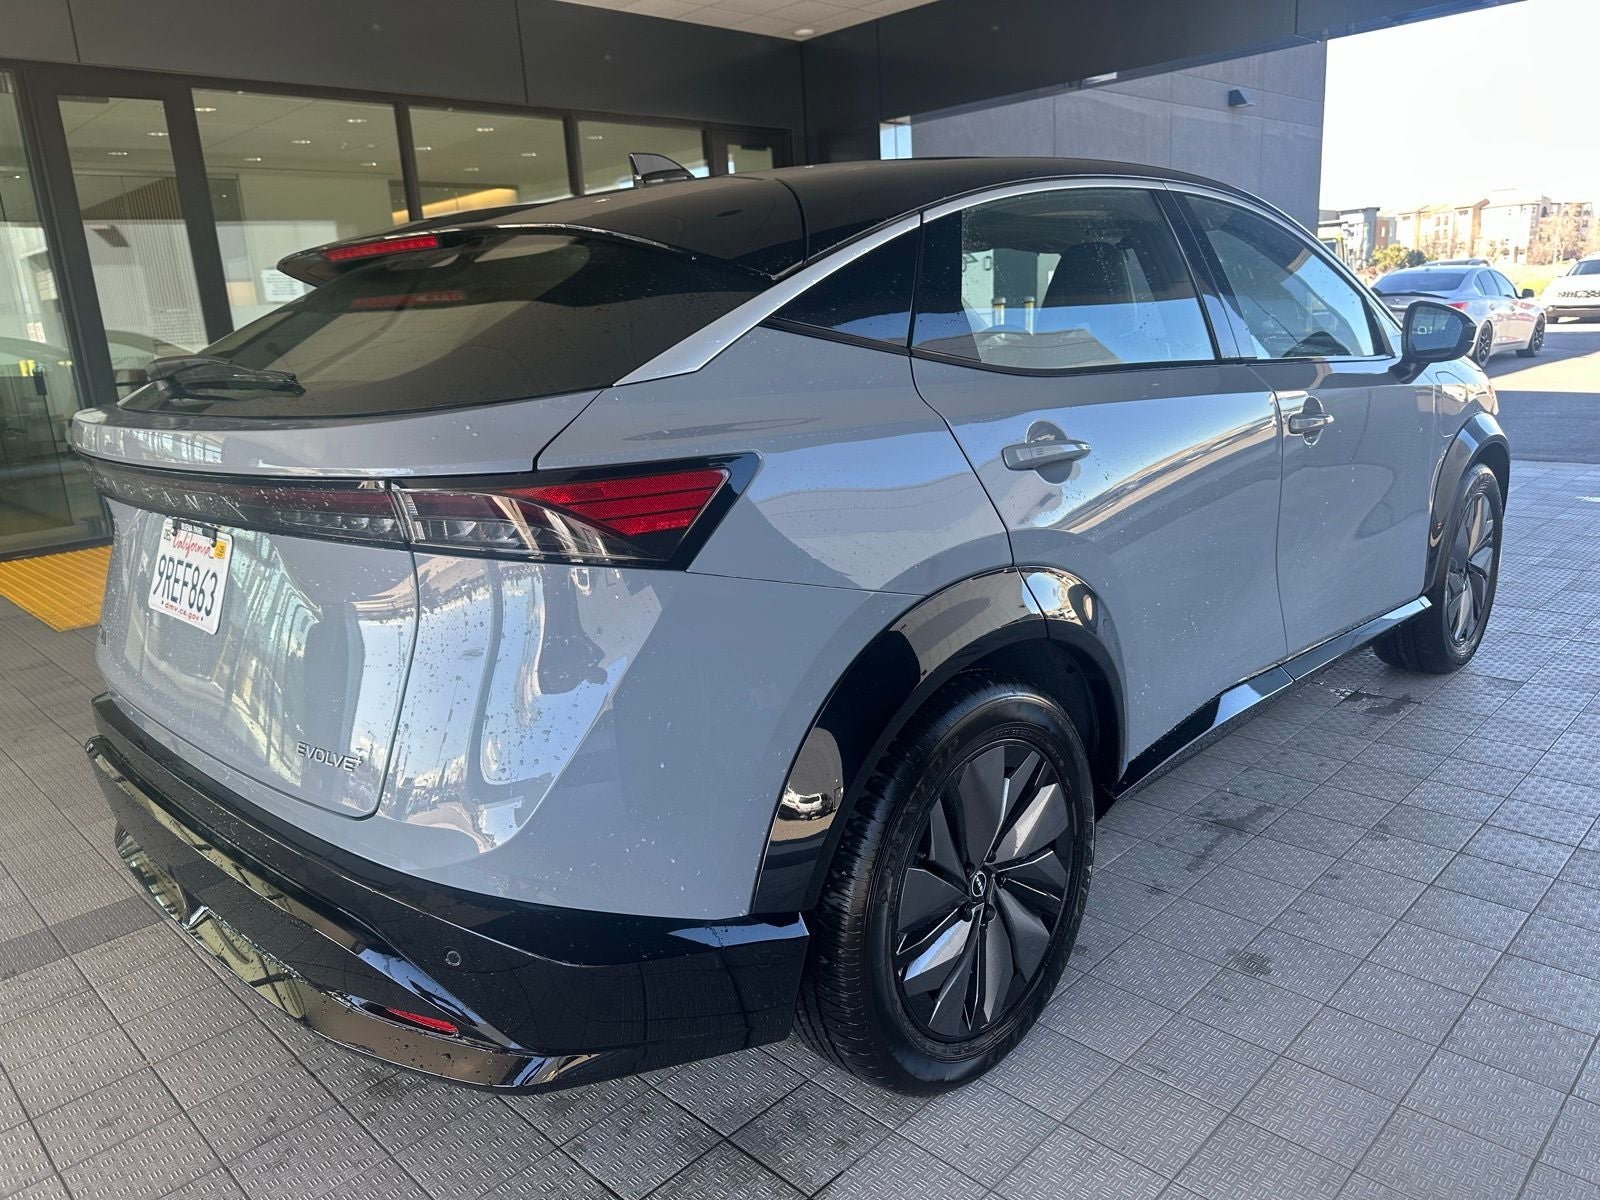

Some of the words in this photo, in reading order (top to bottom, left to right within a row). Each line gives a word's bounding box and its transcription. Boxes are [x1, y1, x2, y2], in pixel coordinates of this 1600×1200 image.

[173, 529, 214, 558] California
[153, 554, 218, 616] 9REF863
[164, 603, 200, 621] dmv.ca.gov
